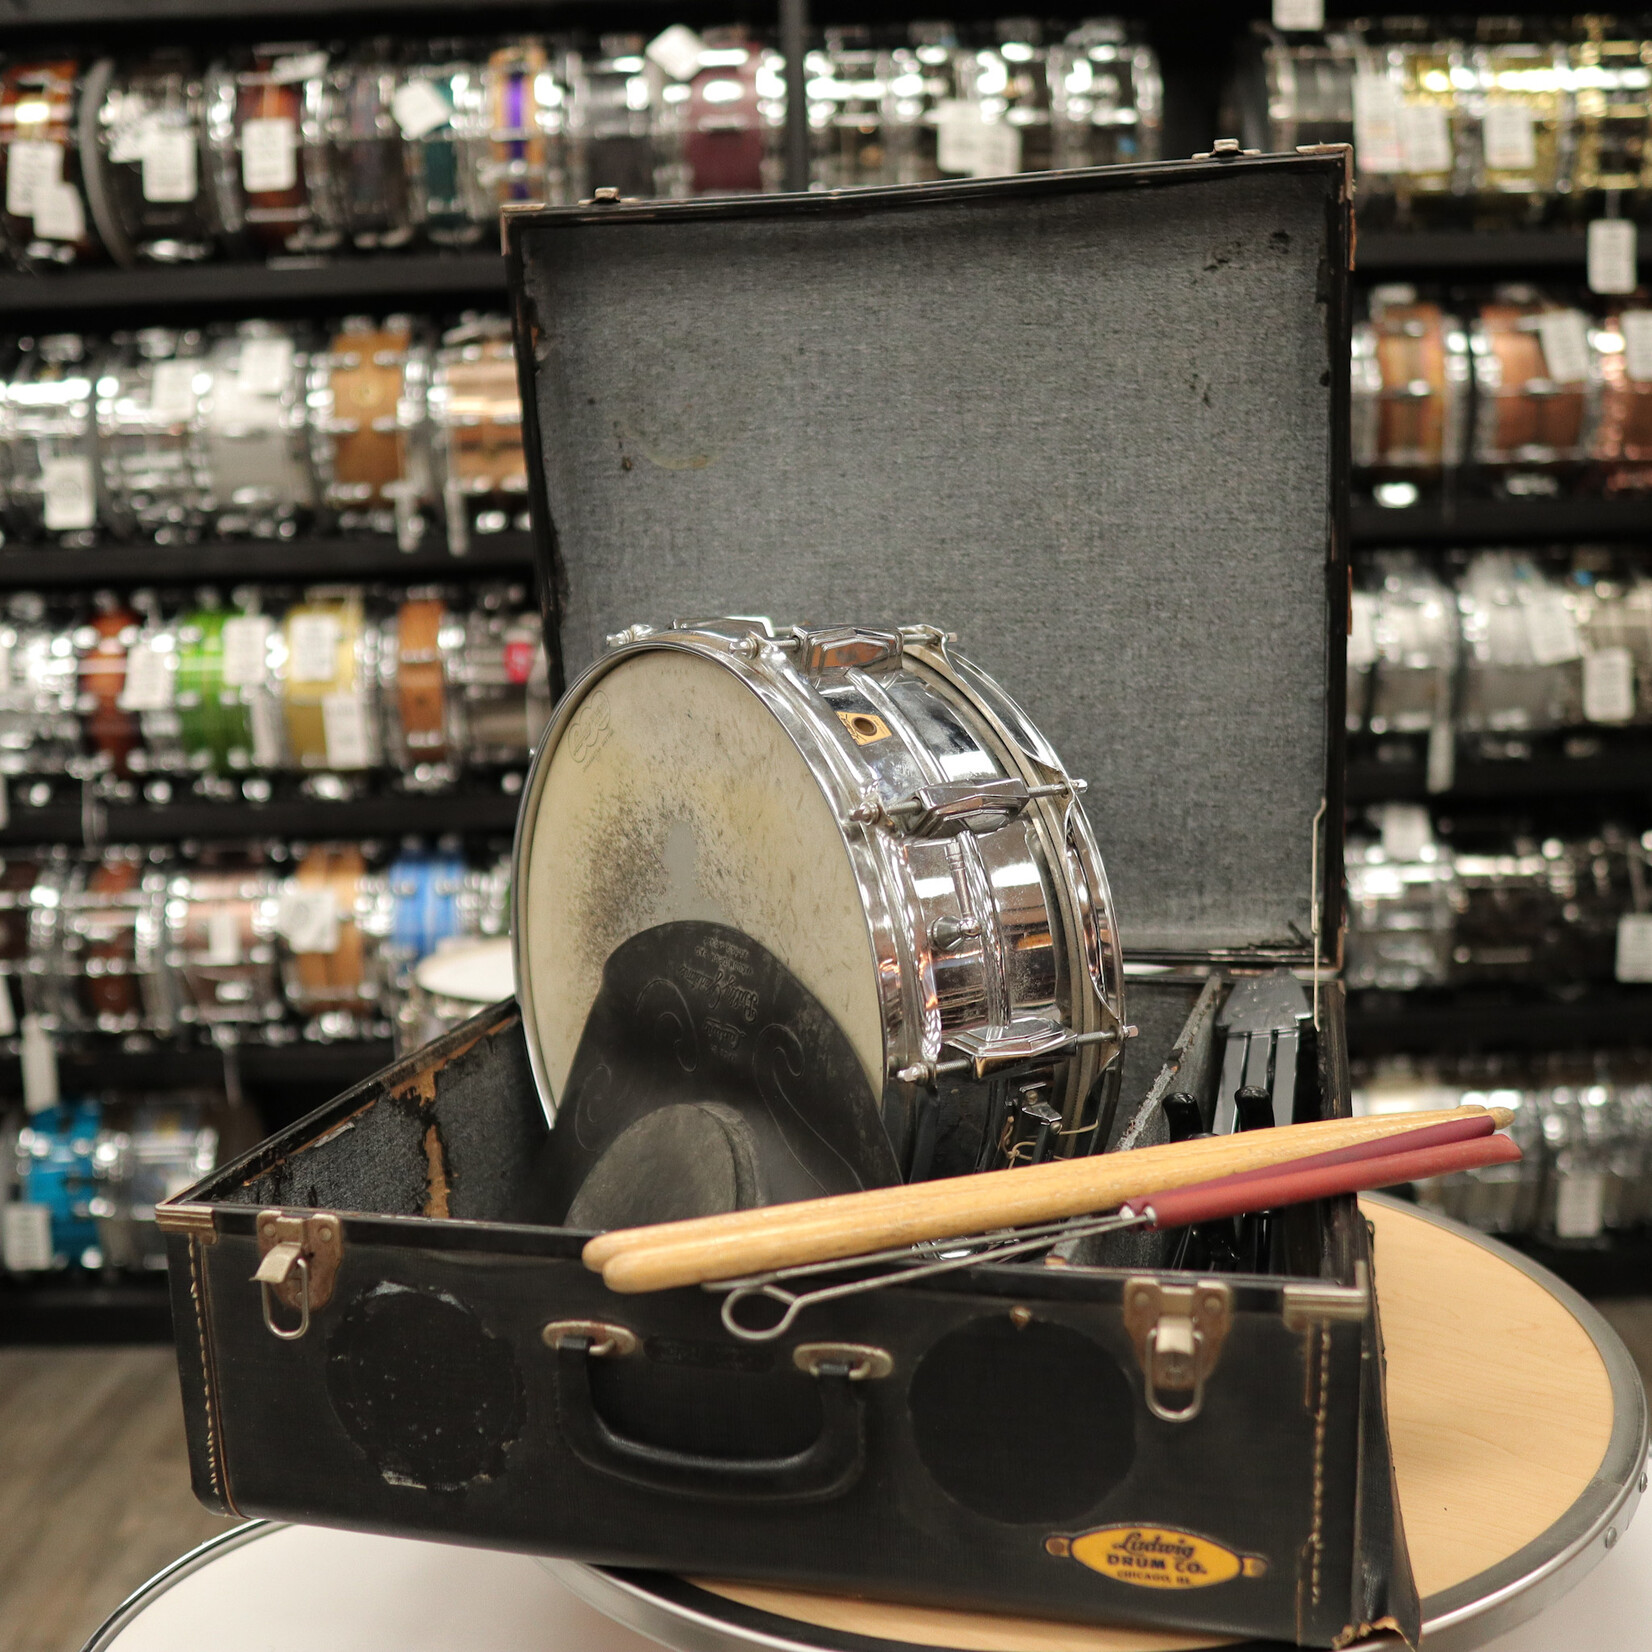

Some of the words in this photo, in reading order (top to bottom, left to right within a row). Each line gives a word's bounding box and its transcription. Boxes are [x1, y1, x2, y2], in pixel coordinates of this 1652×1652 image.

[1112, 1532, 1195, 1560] Ludwig
[1107, 1554, 1166, 1569] DRUM
[1174, 1561, 1207, 1575] CO.
